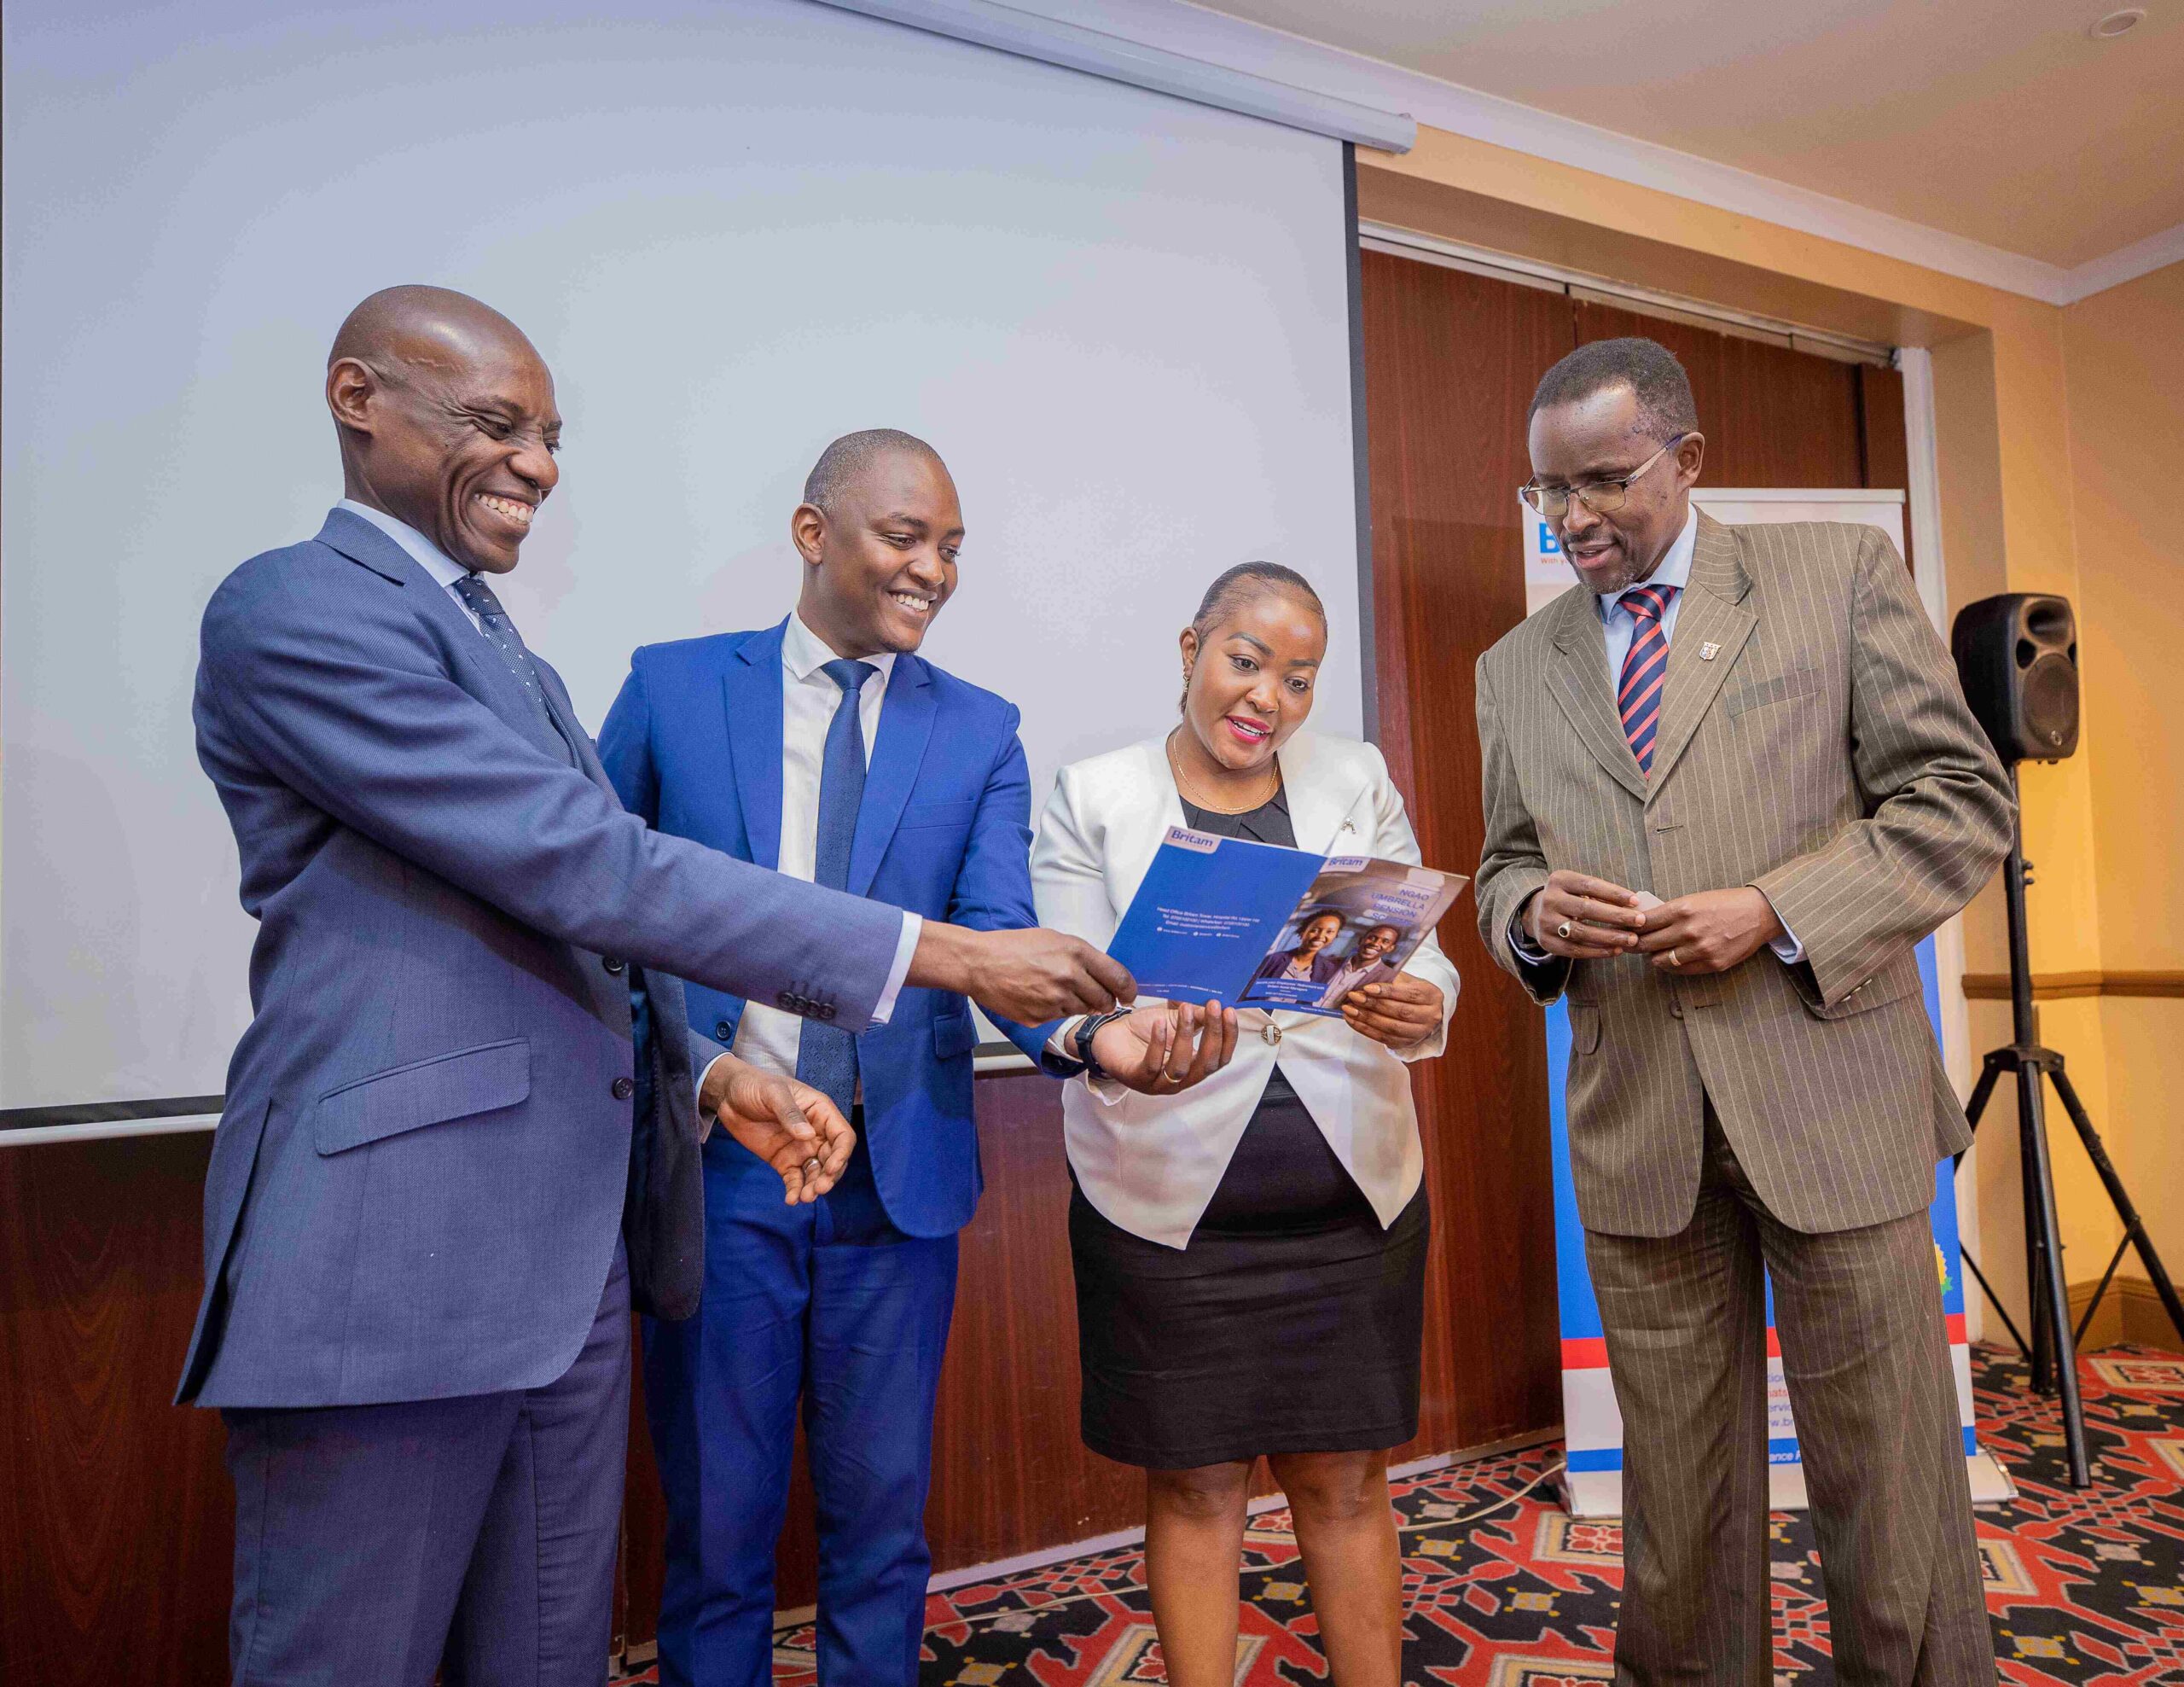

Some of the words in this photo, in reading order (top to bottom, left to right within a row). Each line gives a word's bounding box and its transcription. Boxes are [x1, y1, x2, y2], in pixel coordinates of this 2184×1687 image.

[1171, 829, 1213, 846] Britam
[1328, 857, 1363, 866] Britam
[1371, 893, 1425, 910] UMBRELLA
[1399, 889, 1430, 901] NGAO
[1372, 903, 1417, 917] PENSION
